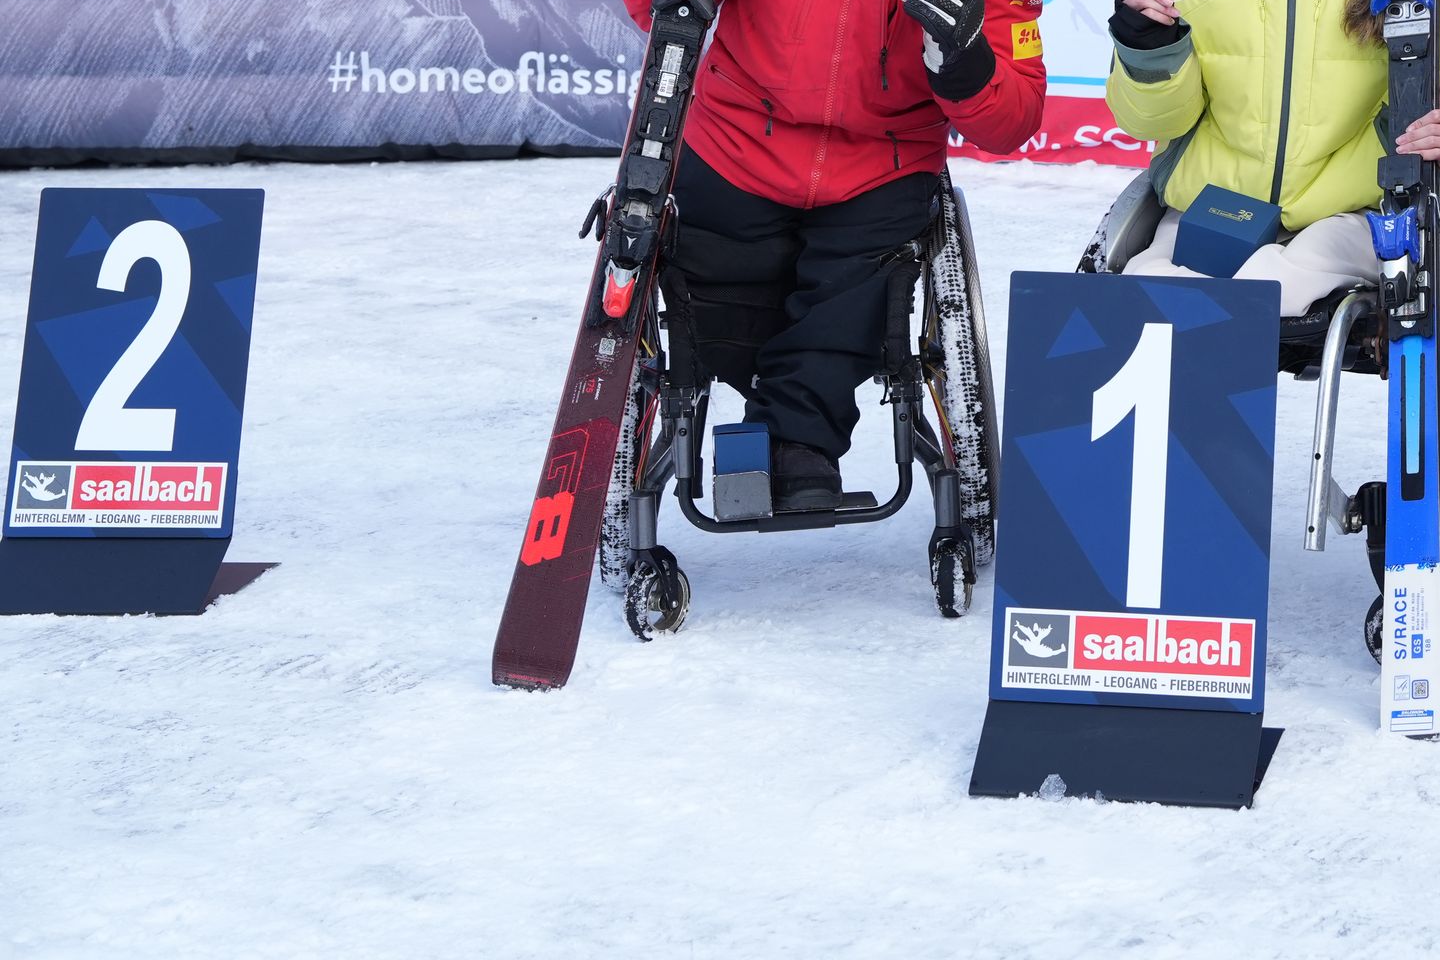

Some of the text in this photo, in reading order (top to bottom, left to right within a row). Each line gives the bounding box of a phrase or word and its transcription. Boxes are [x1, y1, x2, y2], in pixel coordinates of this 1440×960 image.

[74, 220, 192, 452] 2
[79, 465, 213, 502] saalbach
[1091, 322, 1174, 609] 1
[14, 513, 86, 524] HINTERGLEMM
[95, 514, 141, 525] LEOGANG
[150, 514, 218, 525] FIEBERBRUNN
[1082, 618, 1241, 666] saalbach
[1394, 587, 1407, 660] S/RACE
[1413, 638, 1422, 654] GS
[1007, 671, 1091, 687] HINTERGLEMM
[1103, 676, 1158, 690] LEOGANG
[1170, 679, 1251, 694] FIEBERBRUNN
